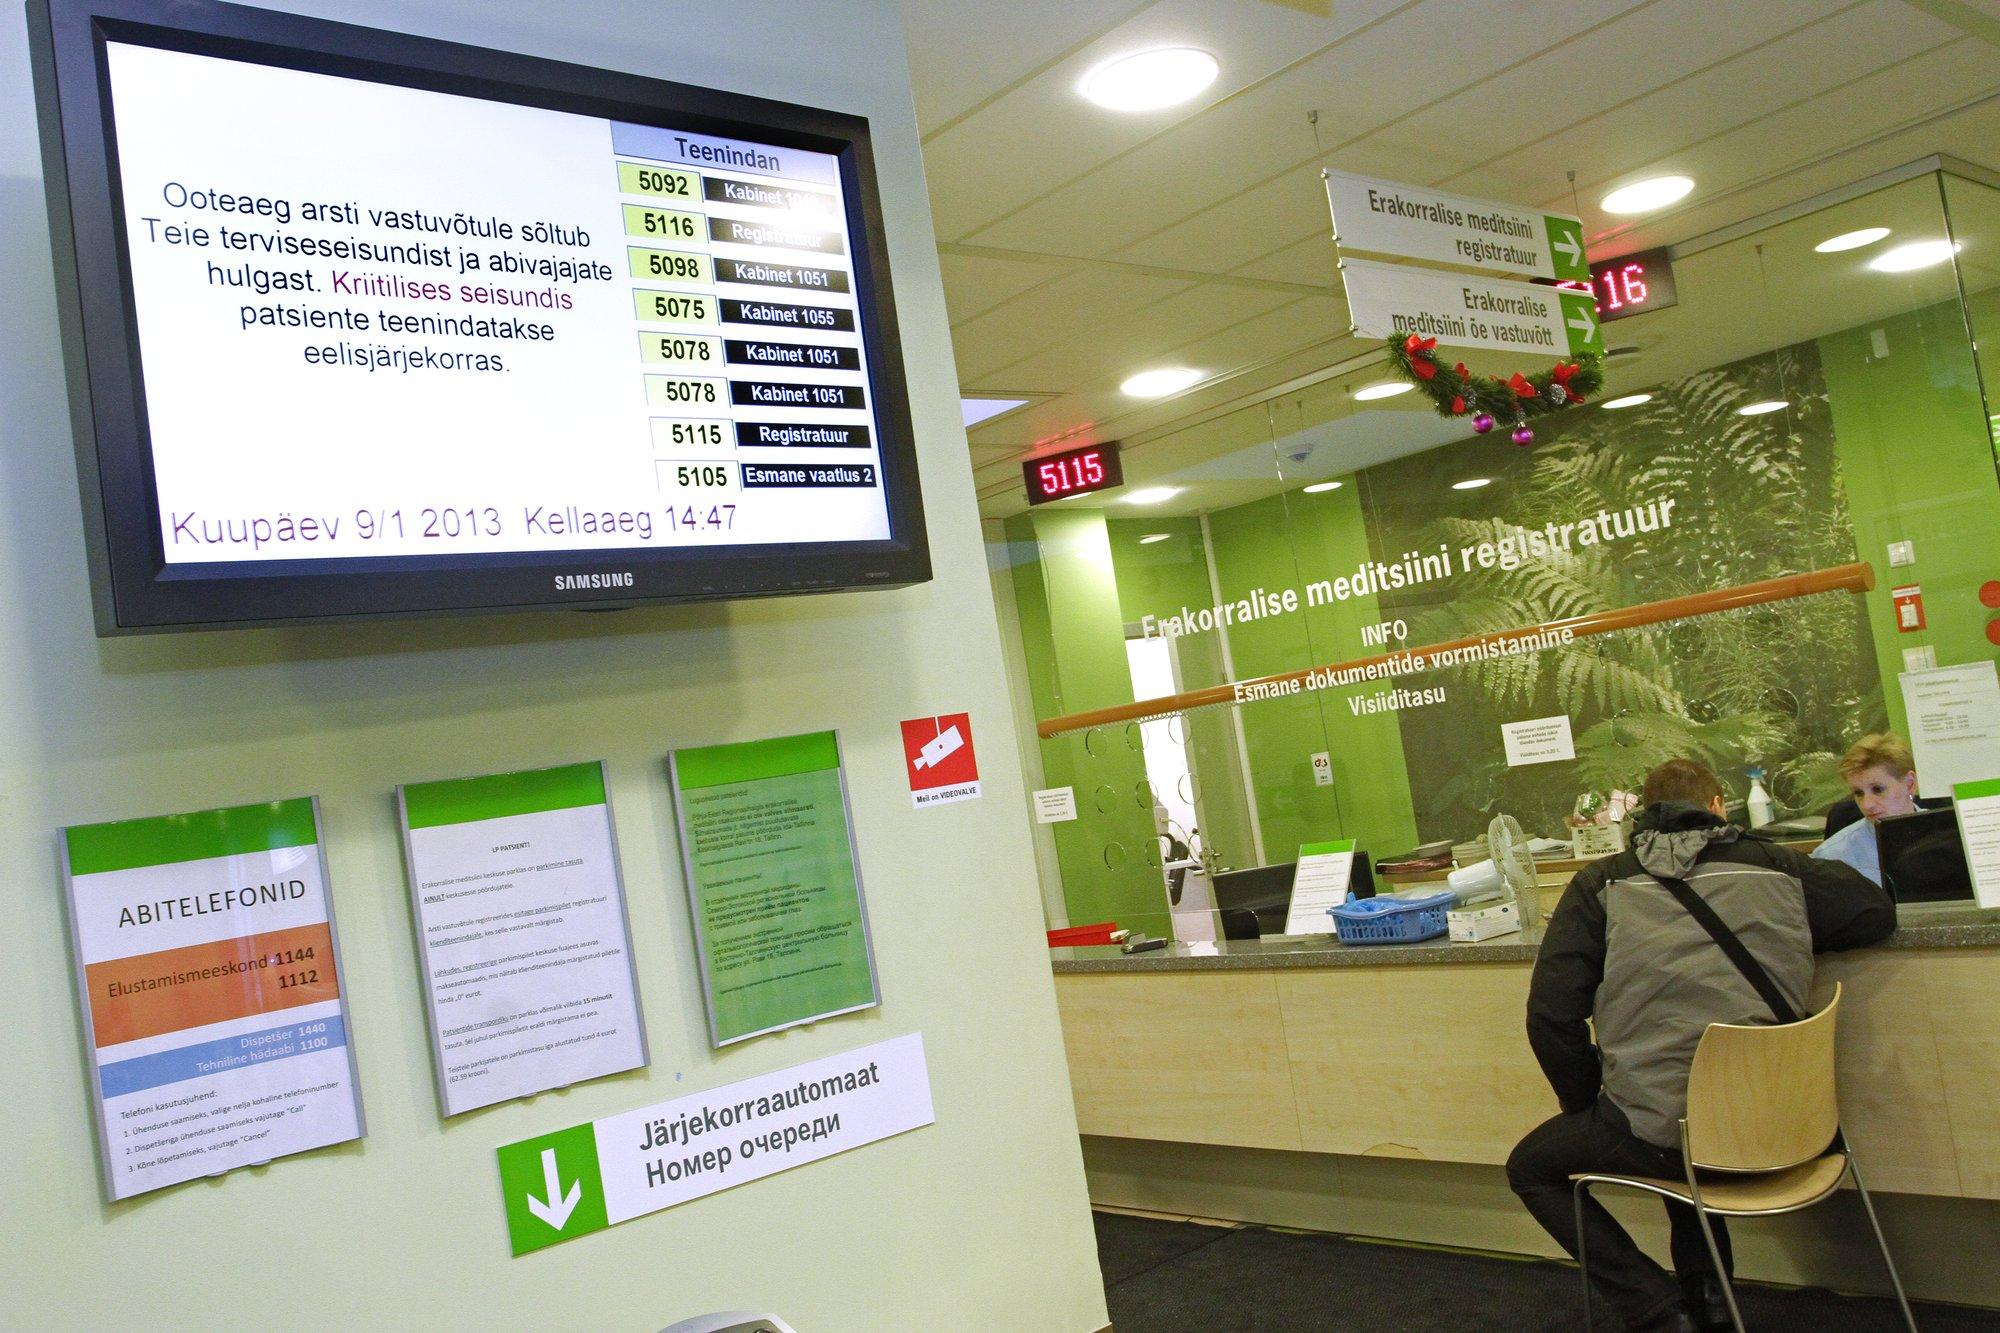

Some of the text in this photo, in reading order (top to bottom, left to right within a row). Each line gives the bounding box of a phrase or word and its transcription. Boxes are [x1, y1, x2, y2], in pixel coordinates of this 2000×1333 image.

[674, 137, 780, 172] Teenindan
[638, 170, 689, 196] 5092
[725, 182, 782, 205] Kabinet
[163, 182, 590, 247] Ooteaeg arsti vastuvõtule sõltub
[644, 212, 694, 237] 5116
[1368, 189, 1533, 239] Erakorralise meditsiini
[141, 217, 613, 283] Teie terviseseisundist ja abivajajate
[1456, 236, 1537, 267] registratuur
[207, 261, 573, 309] hulgast. Kriitilises seisundis
[650, 254, 828, 287] 5098 Kabinet 1051
[655, 296, 834, 325] 5075 Kabinet 1055
[1463, 288, 1547, 318] Erakorralise
[240, 304, 555, 341] patsiente teenindatakse
[1392, 311, 1554, 347] meditsiini õe vastuvõtt
[304, 342, 510, 374] eelisjärjekorras.
[660, 339, 839, 365] 5078 Kabinet 1051
[666, 381, 844, 404] 5078 Kabinet 1051
[672, 424, 848, 446] 5115 Registratuur
[677, 466, 872, 486] 5105 Esmane vaatlus 2
[1039, 452, 1103, 494] 5115
[172, 504, 737, 551] Kuupäev 9/1 2013 Kellaaeg 14:47
[555, 572, 633, 591] SAMSUNG
[1141, 498, 1675, 642] Erakorralise meditsiini registratuur
[1361, 619, 1408, 647] INFO
[1234, 627, 1574, 704] Esmane dokumentide vormistamine
[1347, 686, 1446, 716] Visiiditasu
[916, 786, 977, 803] Meil on VIDEOVALVE
[119, 879, 306, 928] ABITELEFONID
[108, 946, 315, 998] Elustamismeeskond 1144
[278, 970, 319, 990] 1112
[241, 1022, 326, 1050] Dispetšer 1440
[196, 1037, 328, 1073] Tehniline hädaabi 1100
[121, 1090, 217, 1119] Telefoni kasutusjuhend:
[124, 1080, 338, 1137] 1. Ühenduse saamiseks, valige nelja kohaline telefoninumber
[640, 1061, 880, 1152] Järjekorraautomaat
[126, 1146, 132, 1154] 2.
[180, 1126, 215, 1141] ühenduse
[217, 1117, 253, 1131] saamiseks
[254, 1109, 284, 1124] vajutage
[128, 1164, 135, 1172] 3.
[137, 1158, 155, 1169] Kõne
[207, 1137, 238, 1153] vajutage
[645, 1113, 842, 1188] Номер очереди
